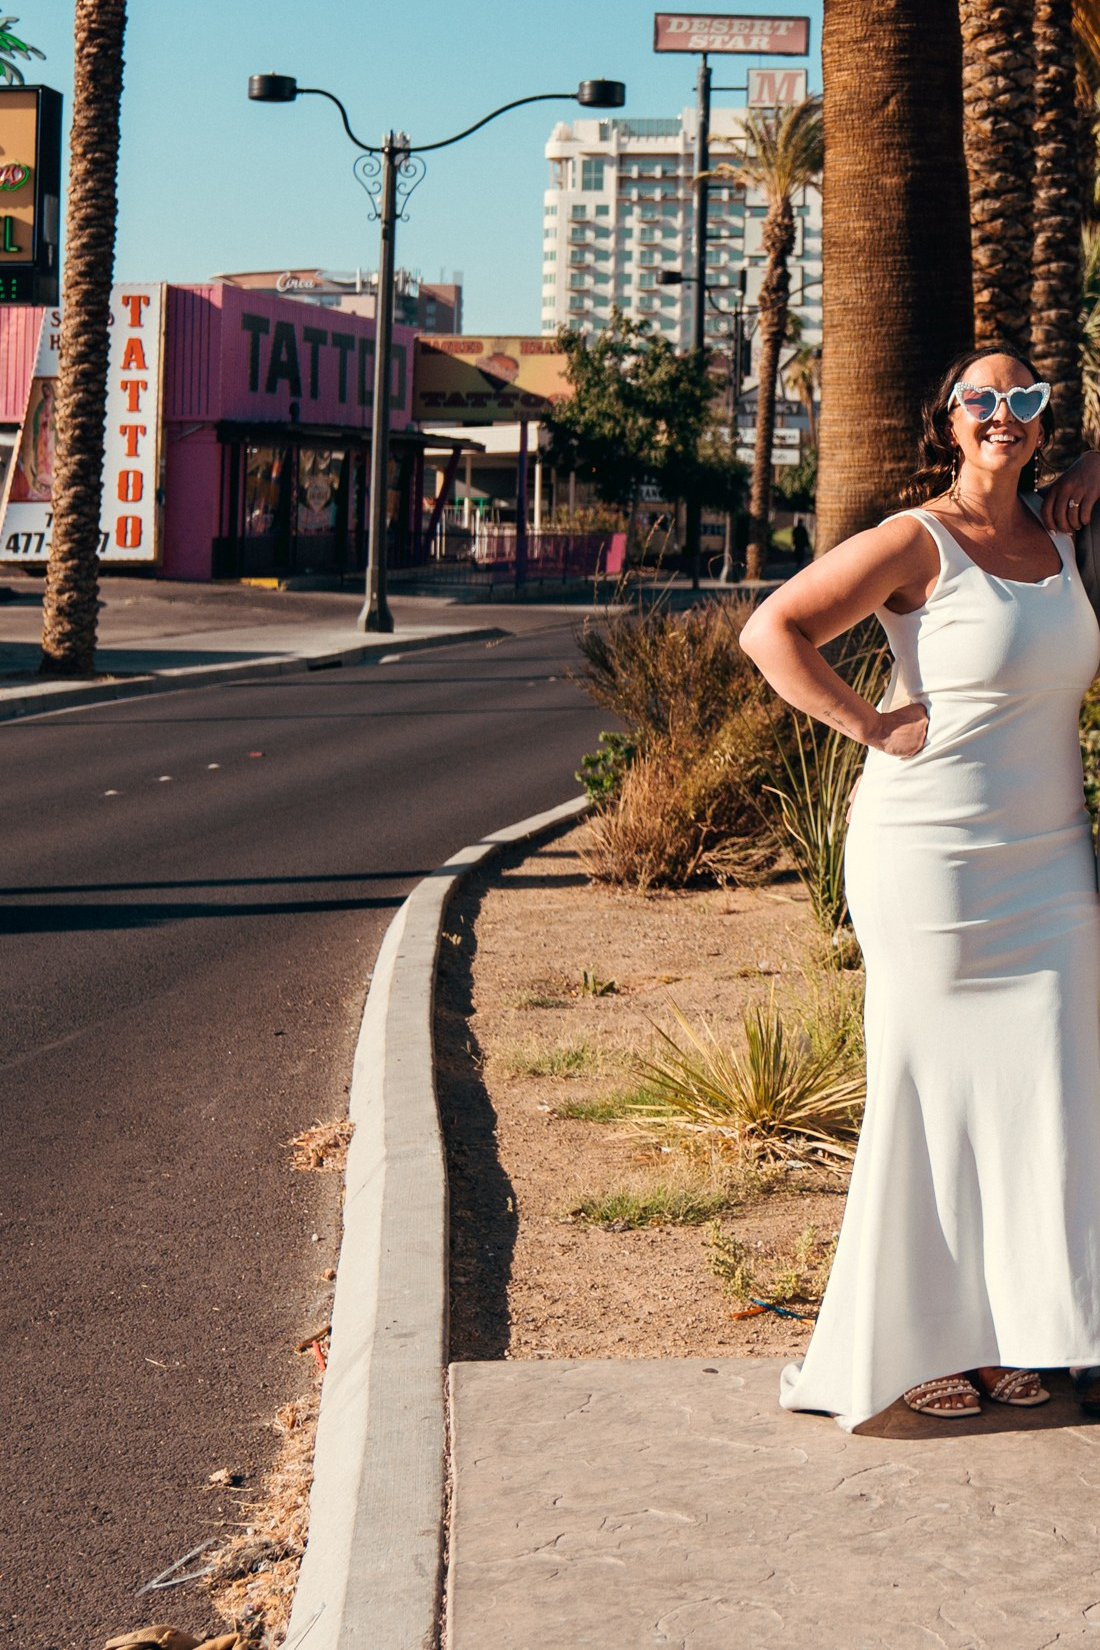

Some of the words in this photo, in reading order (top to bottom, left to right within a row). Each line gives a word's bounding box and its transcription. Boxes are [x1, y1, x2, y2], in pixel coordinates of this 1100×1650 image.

[666, 18, 795, 36] DESERT
[688, 35, 770, 50] STAR
[275, 271, 315, 292] Circa
[520, 341, 566, 354] HEA
[242, 312, 407, 411] TATTOO
[115, 295, 150, 548] TATTOO
